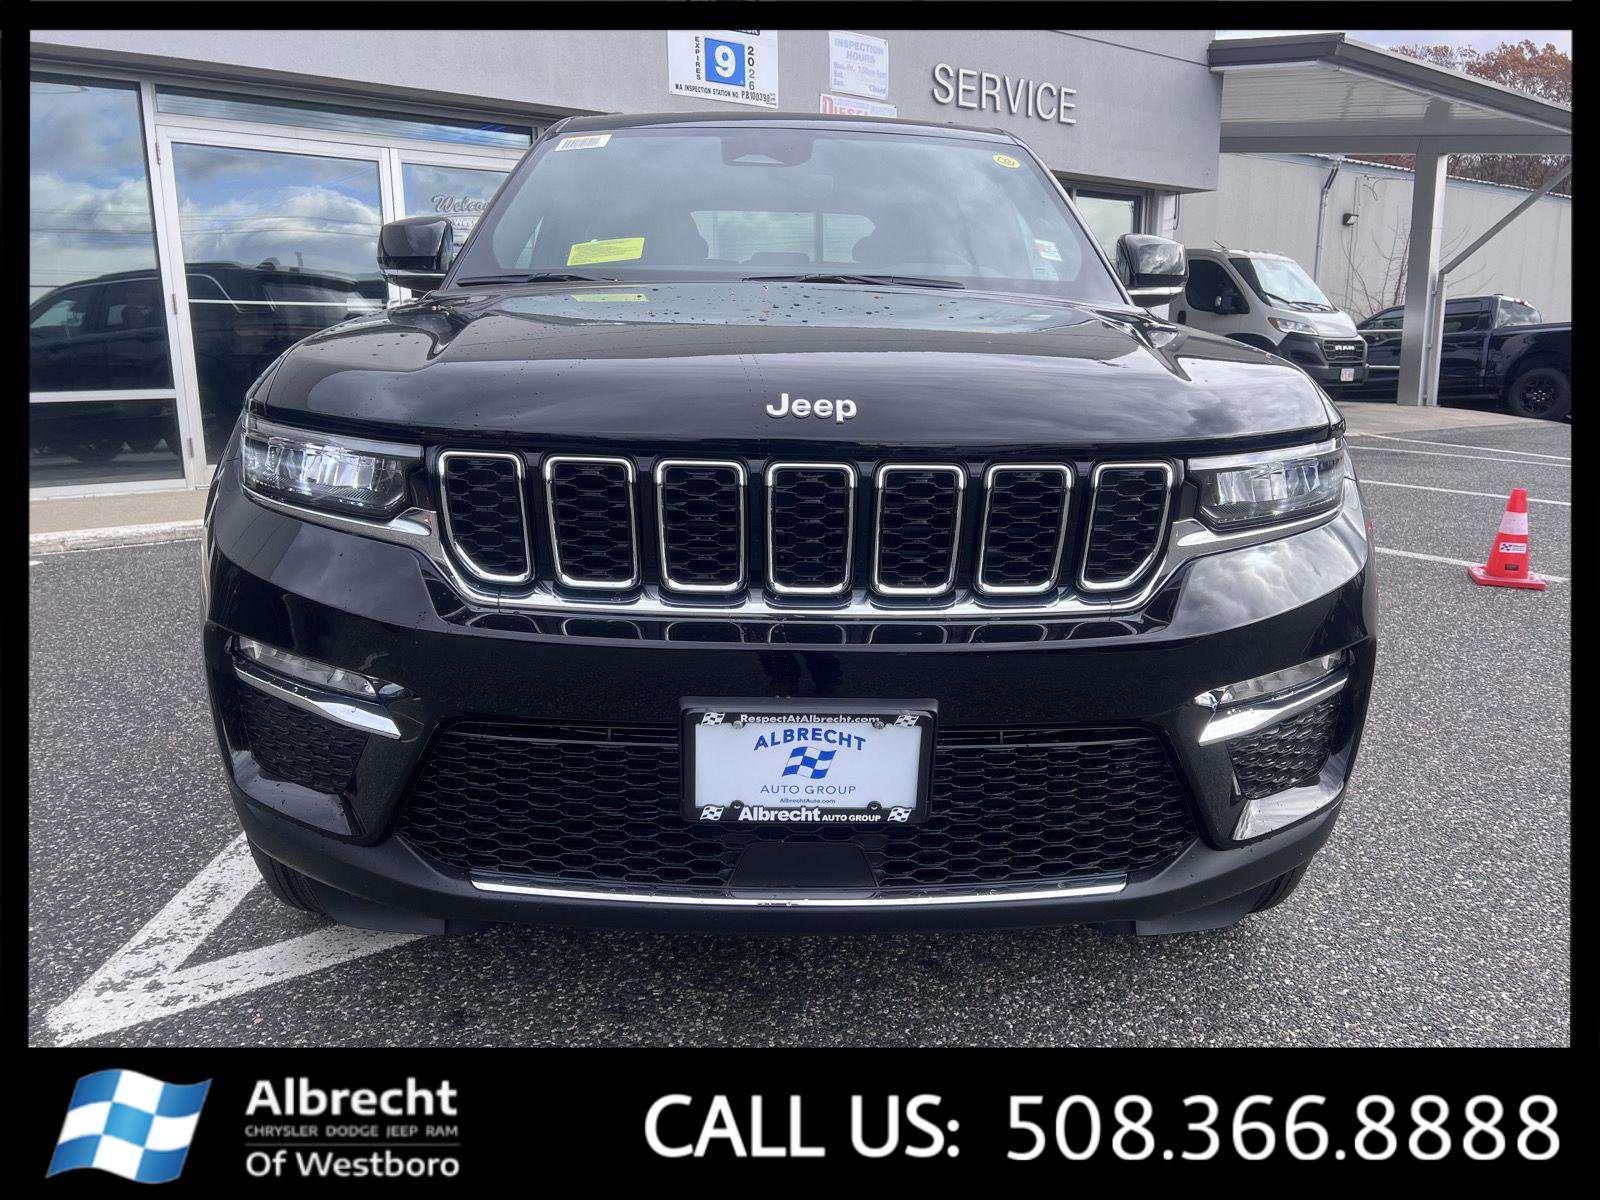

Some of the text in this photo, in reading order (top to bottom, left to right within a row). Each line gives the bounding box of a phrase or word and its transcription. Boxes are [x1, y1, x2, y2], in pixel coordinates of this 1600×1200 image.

[834, 38, 884, 55] INSPECTION
[715, 45, 736, 78] 9
[846, 50, 876, 64] HOURS
[747, 46, 755, 91] 2026
[685, 84, 712, 94] INSPECTION
[713, 88, 731, 97] STATION
[933, 63, 1077, 125] SERVICE
[766, 393, 857, 423] Jeep
[740, 714, 880, 724] RespectAtAlbrecht.com
[753, 727, 867, 751] ALBRECHT
[760, 785, 857, 795] AUTO GROUP
[738, 806, 821, 822] Albrecht
[822, 814, 848, 822] AUTO
